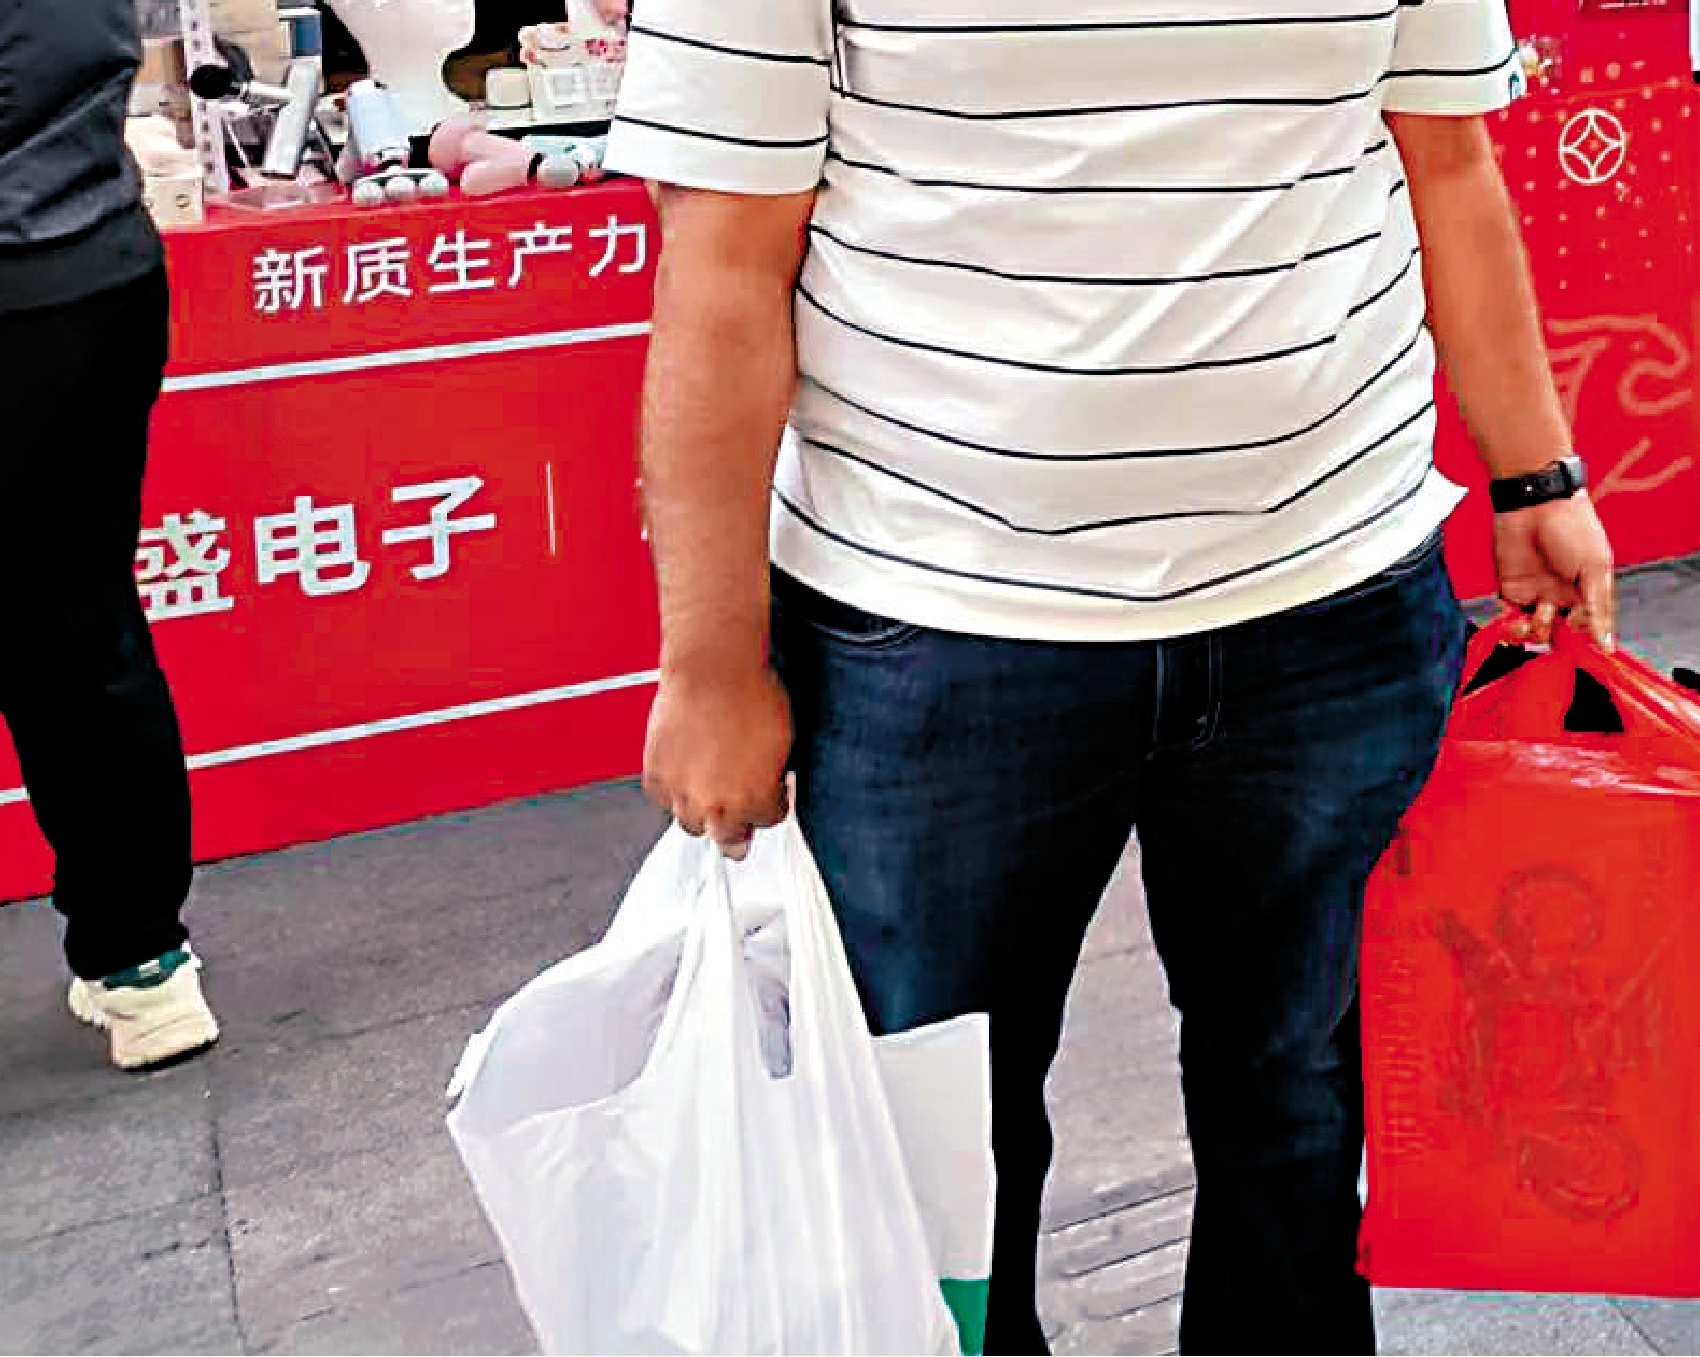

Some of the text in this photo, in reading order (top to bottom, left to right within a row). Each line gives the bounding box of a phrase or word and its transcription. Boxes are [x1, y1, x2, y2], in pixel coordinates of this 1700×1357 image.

[253, 215, 648, 315] 新质生产力
[134, 475, 497, 623] 盛电子
